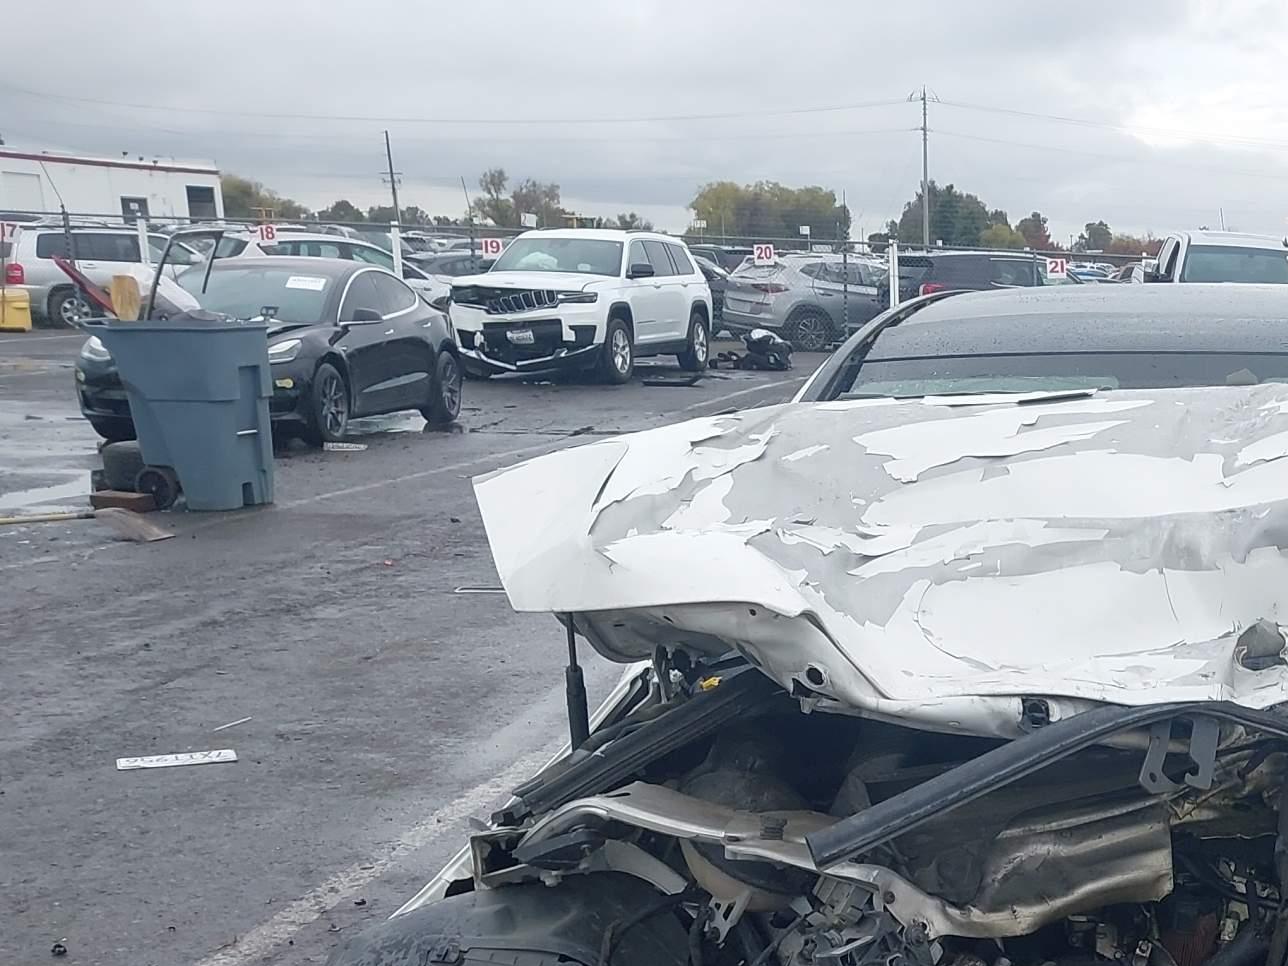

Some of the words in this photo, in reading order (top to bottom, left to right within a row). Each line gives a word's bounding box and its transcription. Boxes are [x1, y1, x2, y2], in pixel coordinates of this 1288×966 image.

[1, 222, 17, 238] 17
[260, 225, 275, 240] 18
[484, 239, 500, 254] 19
[756, 246, 772, 260] 20
[1049, 260, 1065, 273] 21
